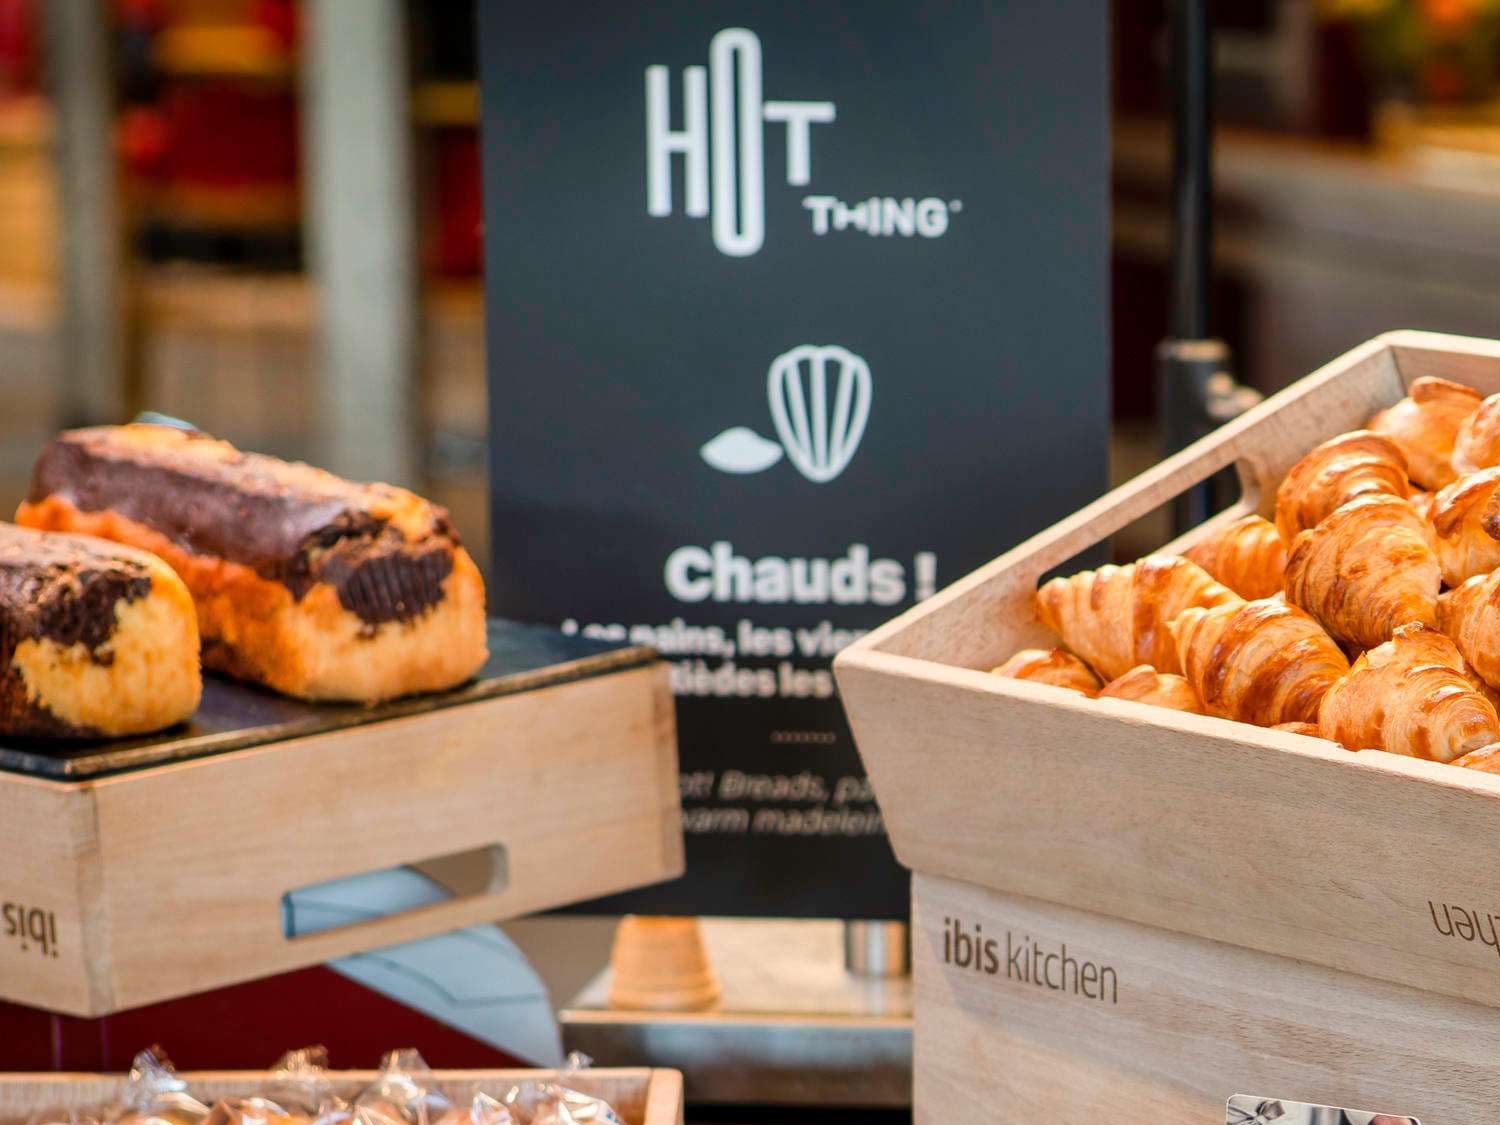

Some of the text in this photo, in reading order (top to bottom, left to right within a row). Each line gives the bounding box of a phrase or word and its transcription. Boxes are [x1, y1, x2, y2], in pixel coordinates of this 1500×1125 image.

[645, 26, 836, 258] HOT
[664, 541, 907, 605] Chauds
[738, 619, 795, 656] les
[779, 661, 833, 698] les
[2, 902, 59, 960] ibis
[944, 916, 1118, 1004] ibis kitchen
